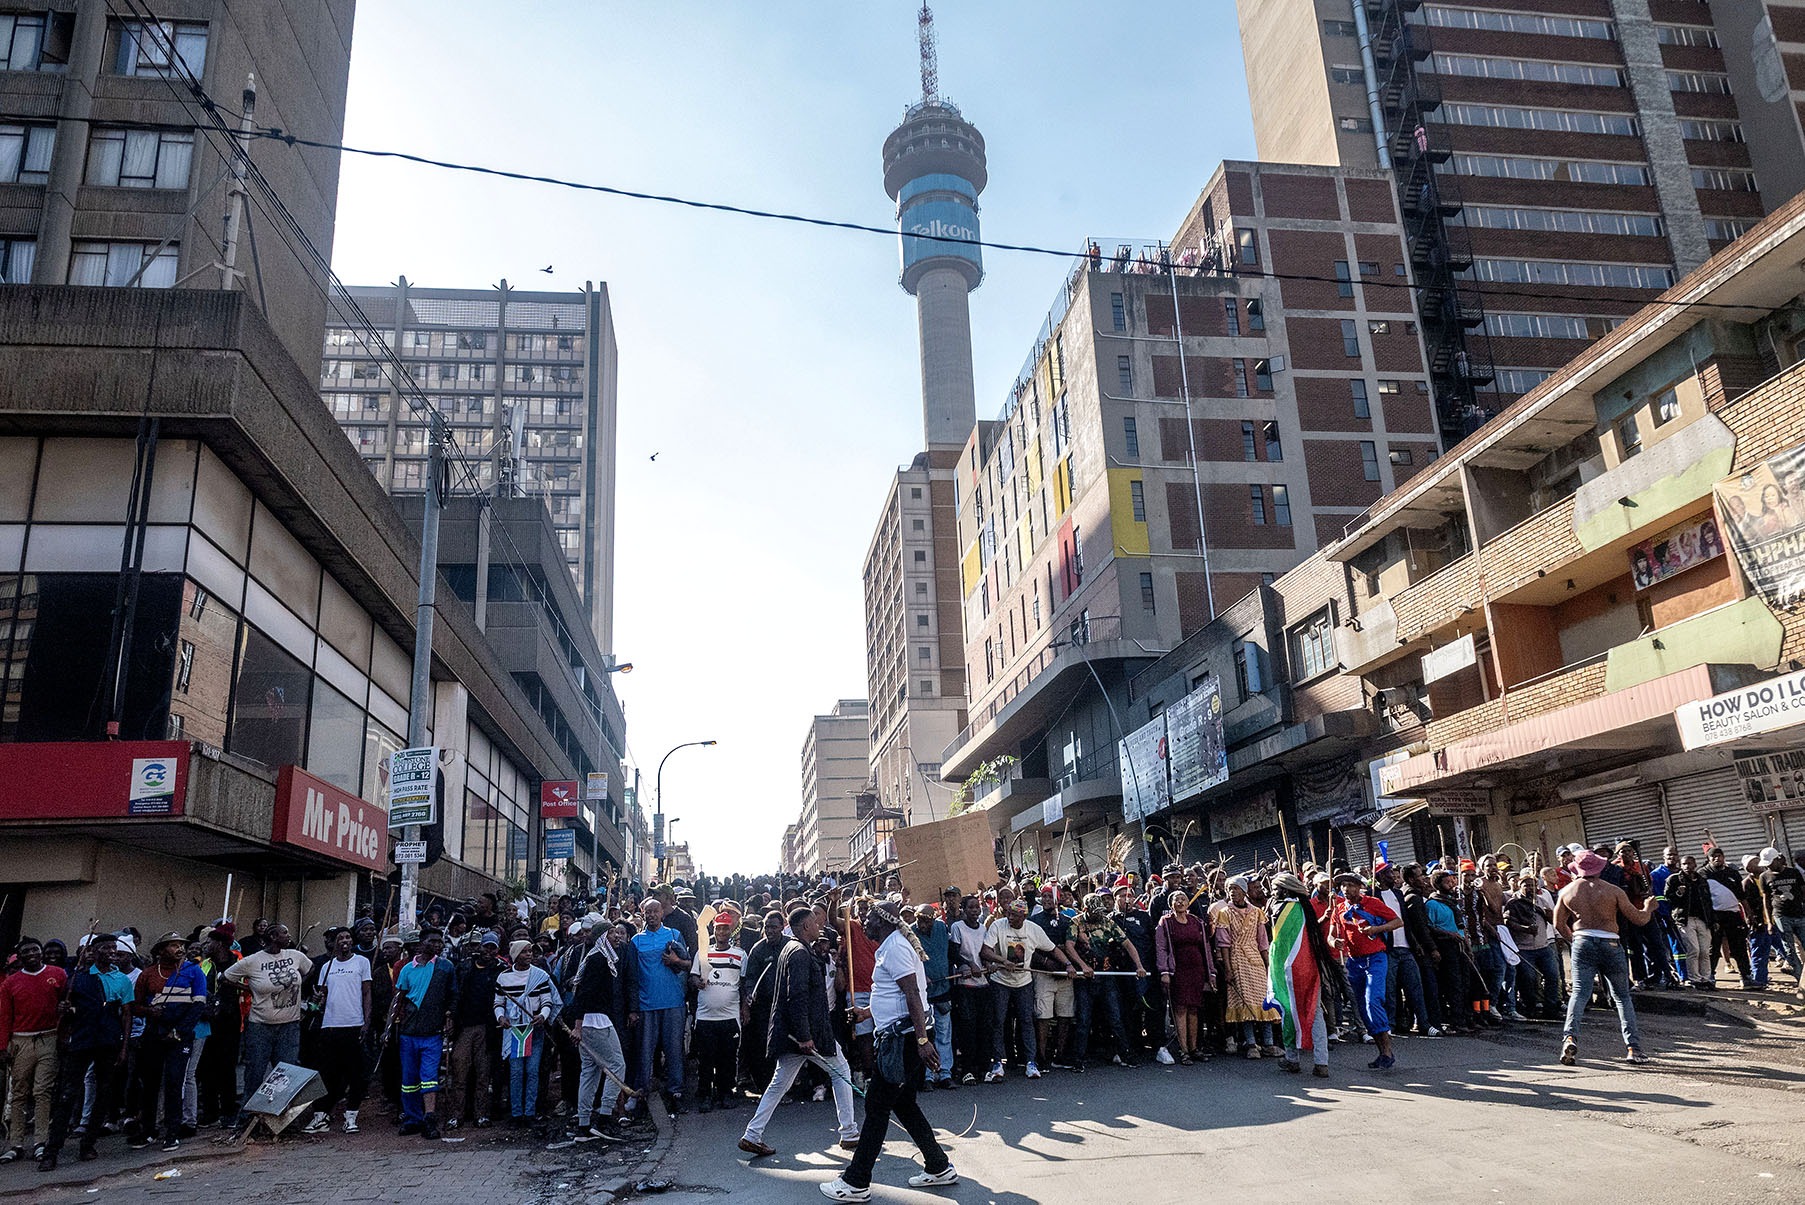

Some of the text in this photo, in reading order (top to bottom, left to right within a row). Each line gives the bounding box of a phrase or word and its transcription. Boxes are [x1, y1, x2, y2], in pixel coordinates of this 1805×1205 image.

[911, 219, 976, 242] Telkom
[1699, 695, 1742, 722] HOW
[1746, 687, 1774, 708] DO
[1777, 683, 1785, 700] I
[1207, 709, 1213, 720] 9
[1702, 713, 1741, 733] BEAUTY
[1743, 703, 1779, 722] SALON
[1781, 701, 1789, 712] &
[1704, 723, 1752, 742] 078 438 8768
[393, 761, 431, 774] COLLEGE
[393, 773, 410, 783] GRADE
[421, 771, 430, 779] 12
[1735, 757, 1771, 779] MILLIK
[302, 787, 378, 860] Mr Price
[261, 957, 294, 971] HEATED
